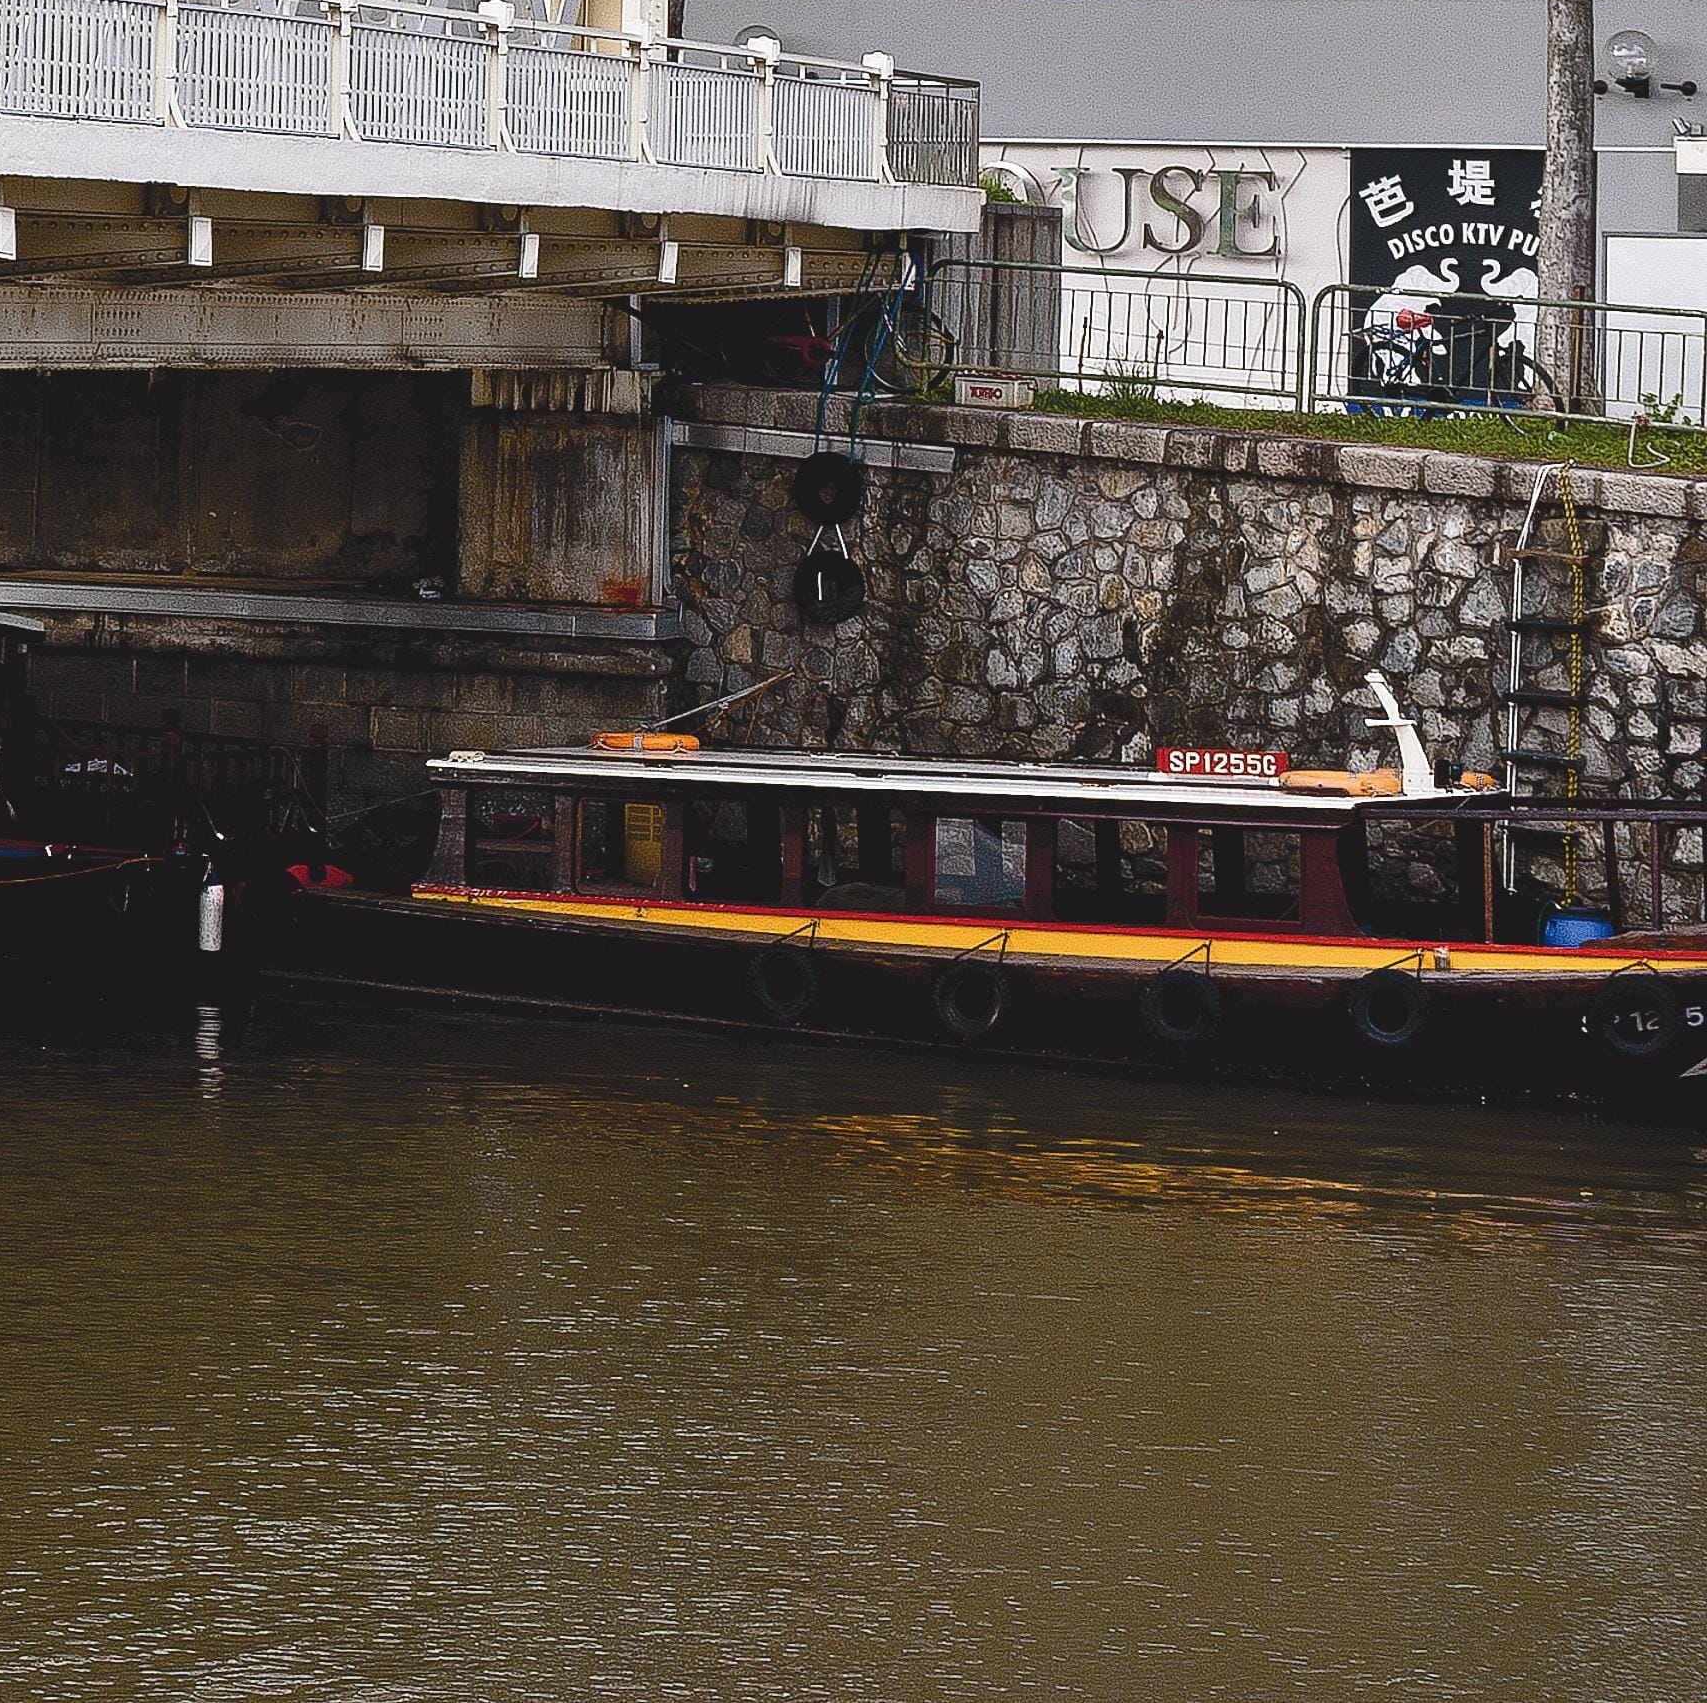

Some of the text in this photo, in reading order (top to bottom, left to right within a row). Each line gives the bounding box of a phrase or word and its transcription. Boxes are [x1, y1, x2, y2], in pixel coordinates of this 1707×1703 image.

[1358, 159, 1542, 228] 芭堤
[1387, 223, 1454, 260] DISCO
[1461, 222, 1505, 246] KTV
[1169, 750, 1278, 776] SP1255G
